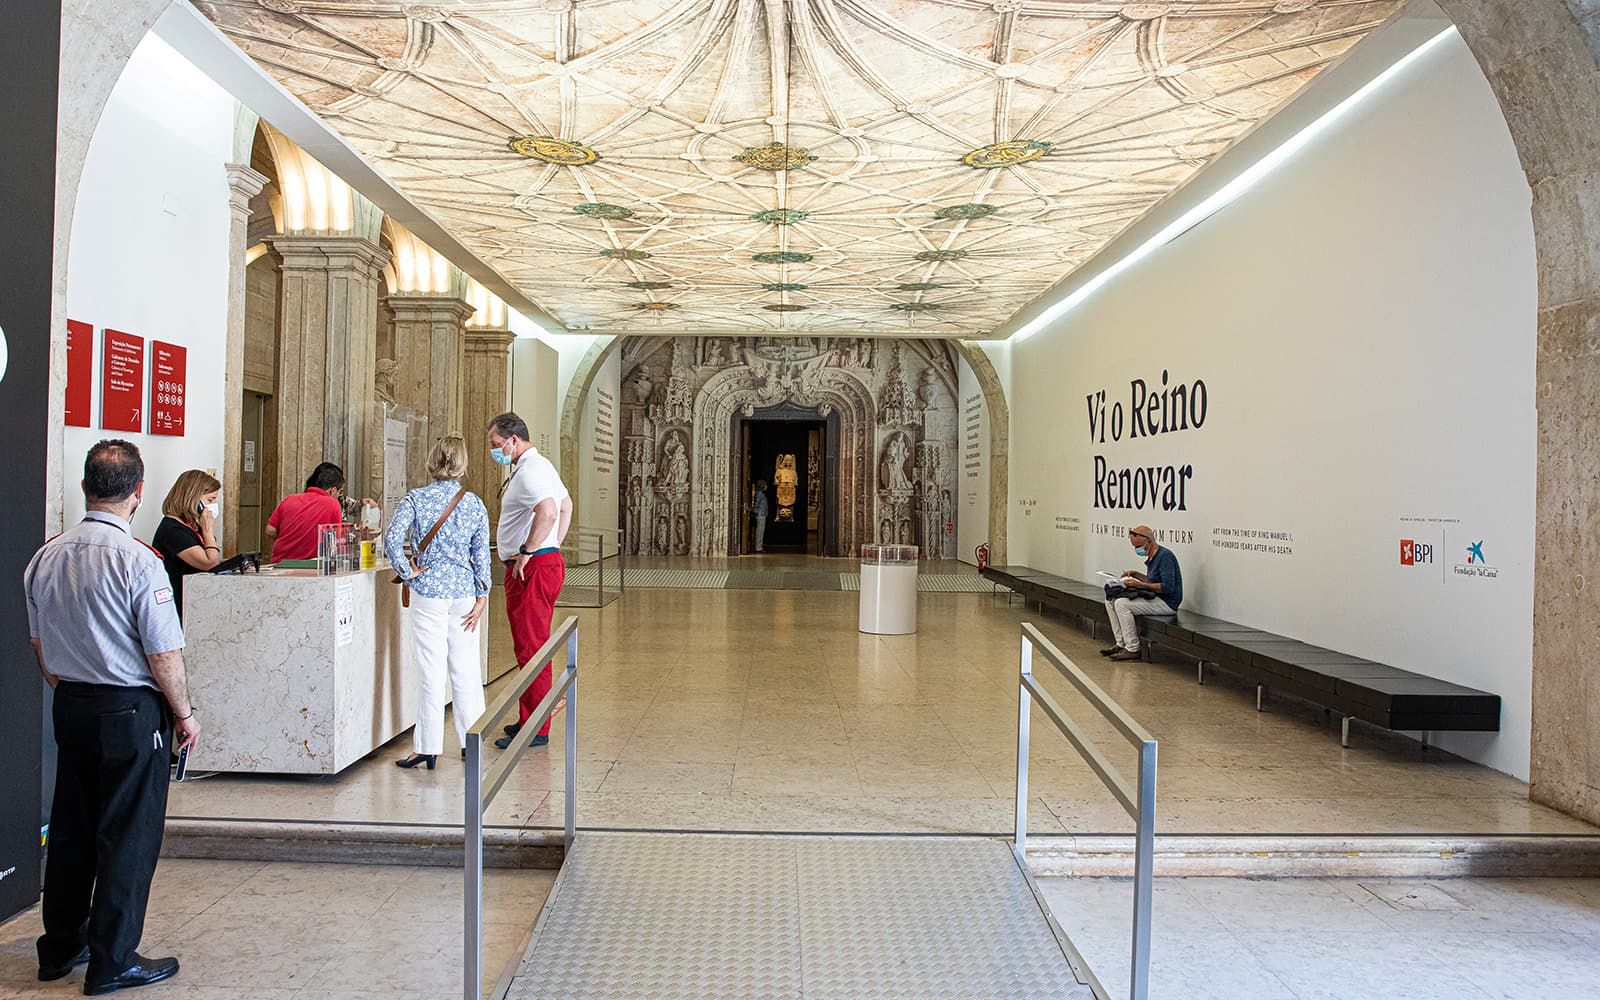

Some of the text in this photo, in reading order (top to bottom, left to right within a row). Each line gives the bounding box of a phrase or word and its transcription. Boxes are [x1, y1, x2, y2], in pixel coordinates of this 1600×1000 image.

[1087, 369, 1207, 445] Vi o Reino
[1093, 455, 1192, 511] Renovar
[1096, 523, 1108, 535] SAW
[1112, 525, 1124, 538] THE
[1169, 530, 1193, 544] TURN
[1221, 528, 1231, 536] FROM
[1241, 529, 1250, 537] TIME
[1258, 531, 1269, 539] KING
[1270, 532, 1288, 540] MANUEL
[1241, 542, 1253, 550] YEARS
[1254, 543, 1267, 552] AFTER
[1277, 546, 1292, 554] DEATH
[1415, 544, 1433, 564] BPI
